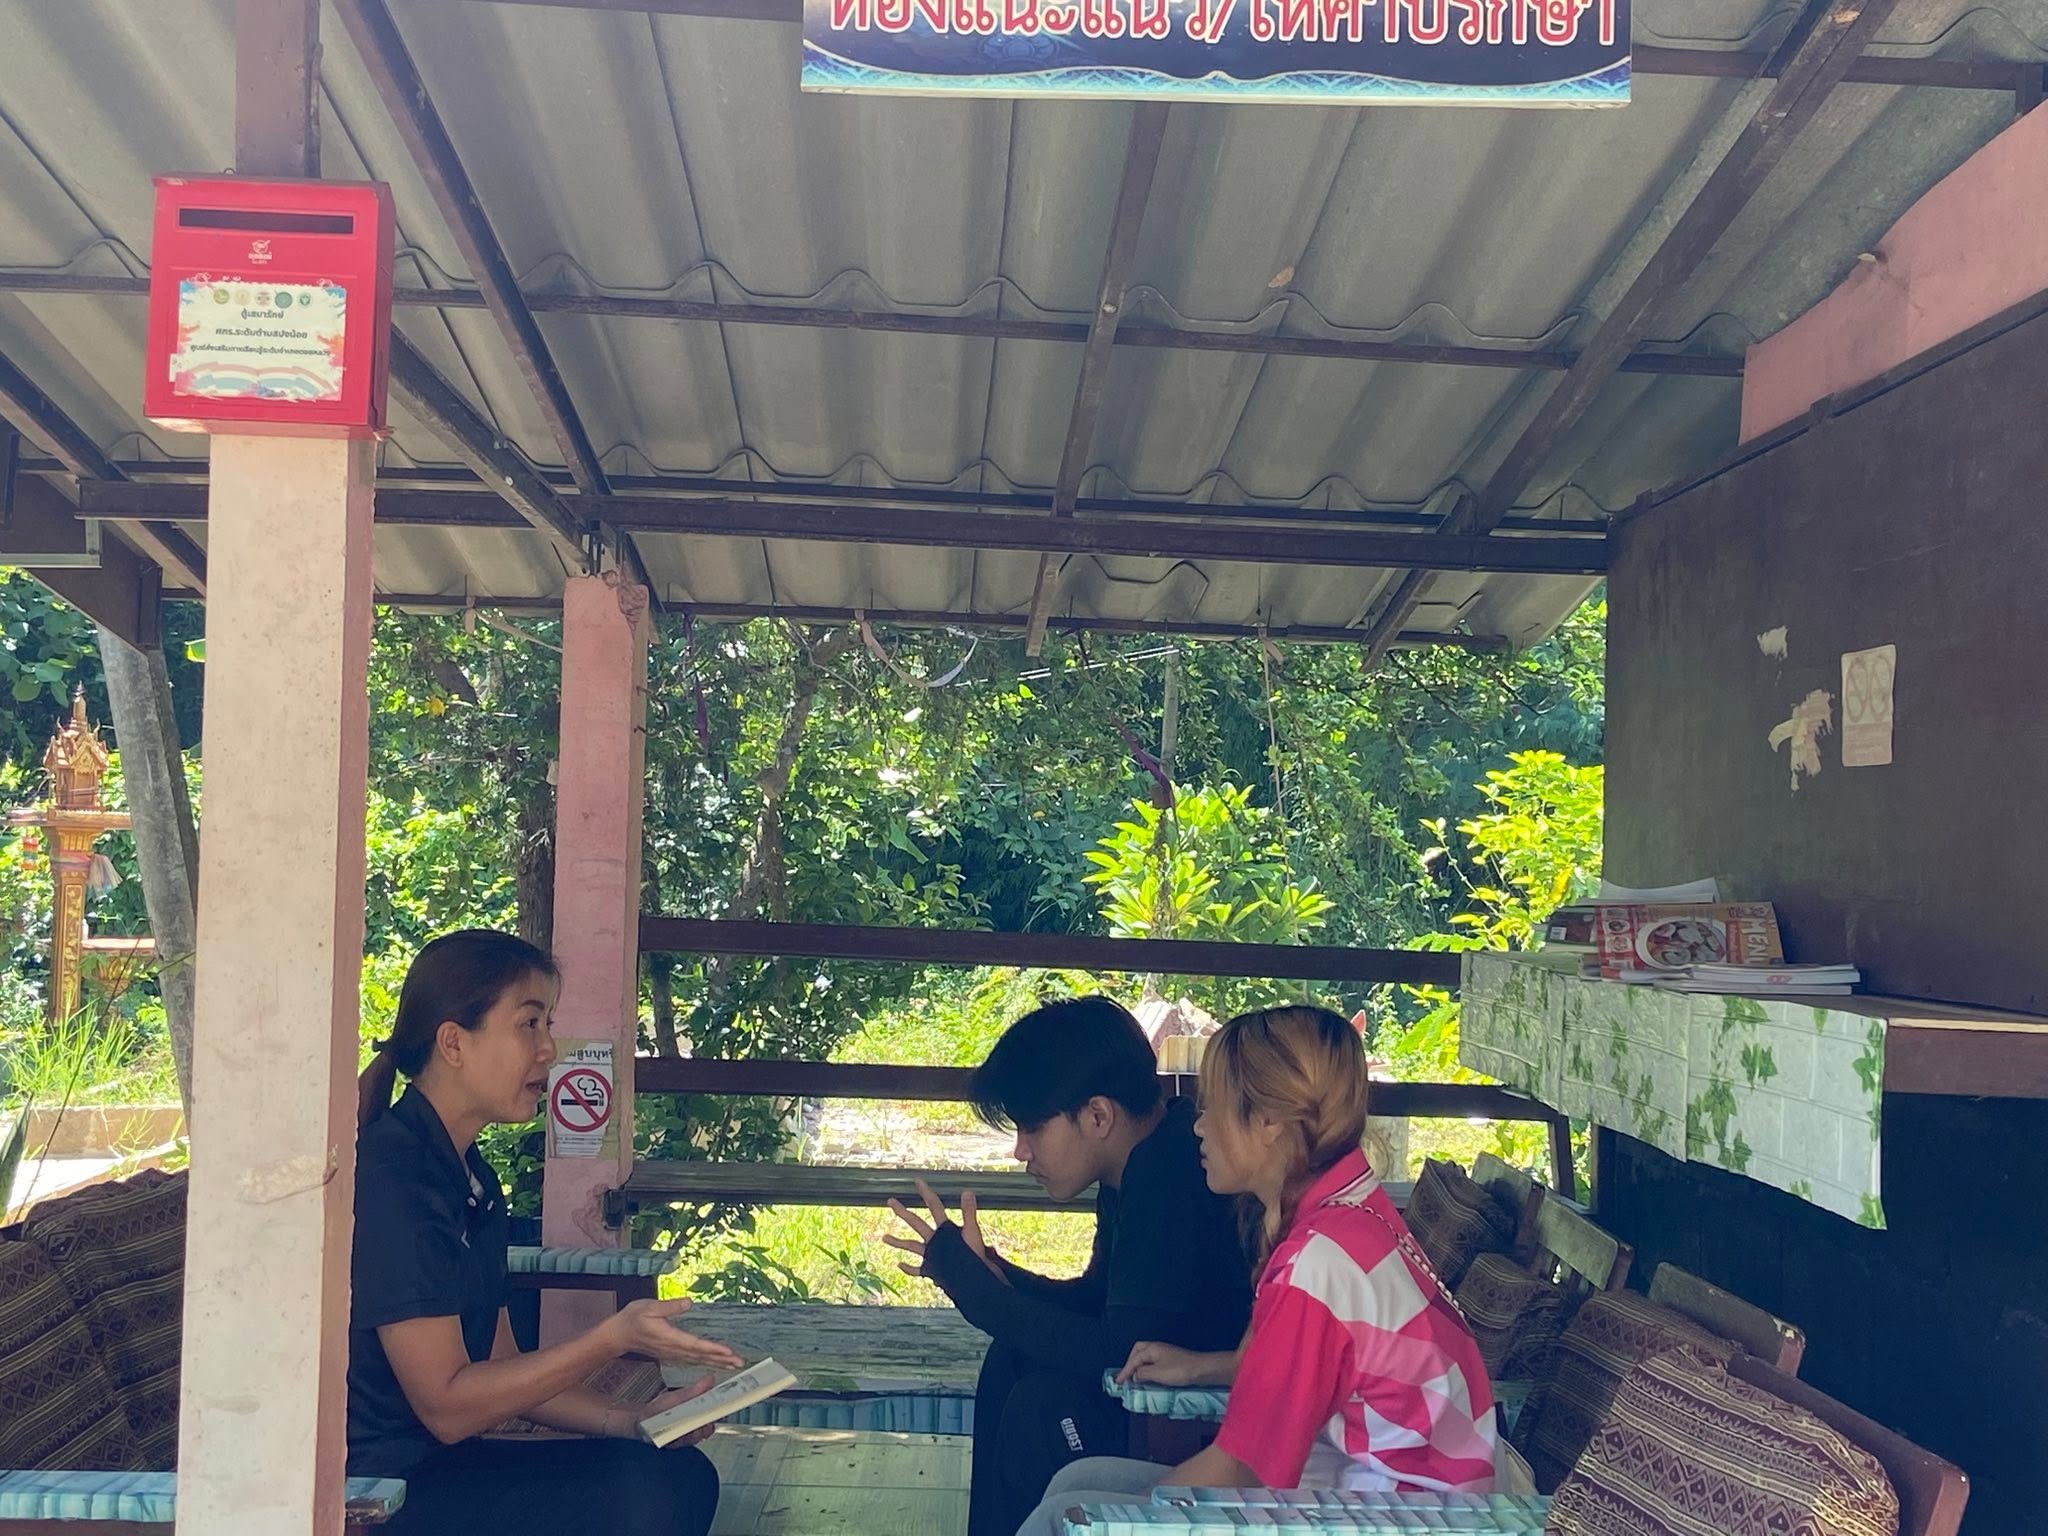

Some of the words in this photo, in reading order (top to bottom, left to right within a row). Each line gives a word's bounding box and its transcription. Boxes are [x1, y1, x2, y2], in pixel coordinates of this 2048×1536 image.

[830, 0, 1613, 44] หองแนะแนว/ใหคำปรกษา
